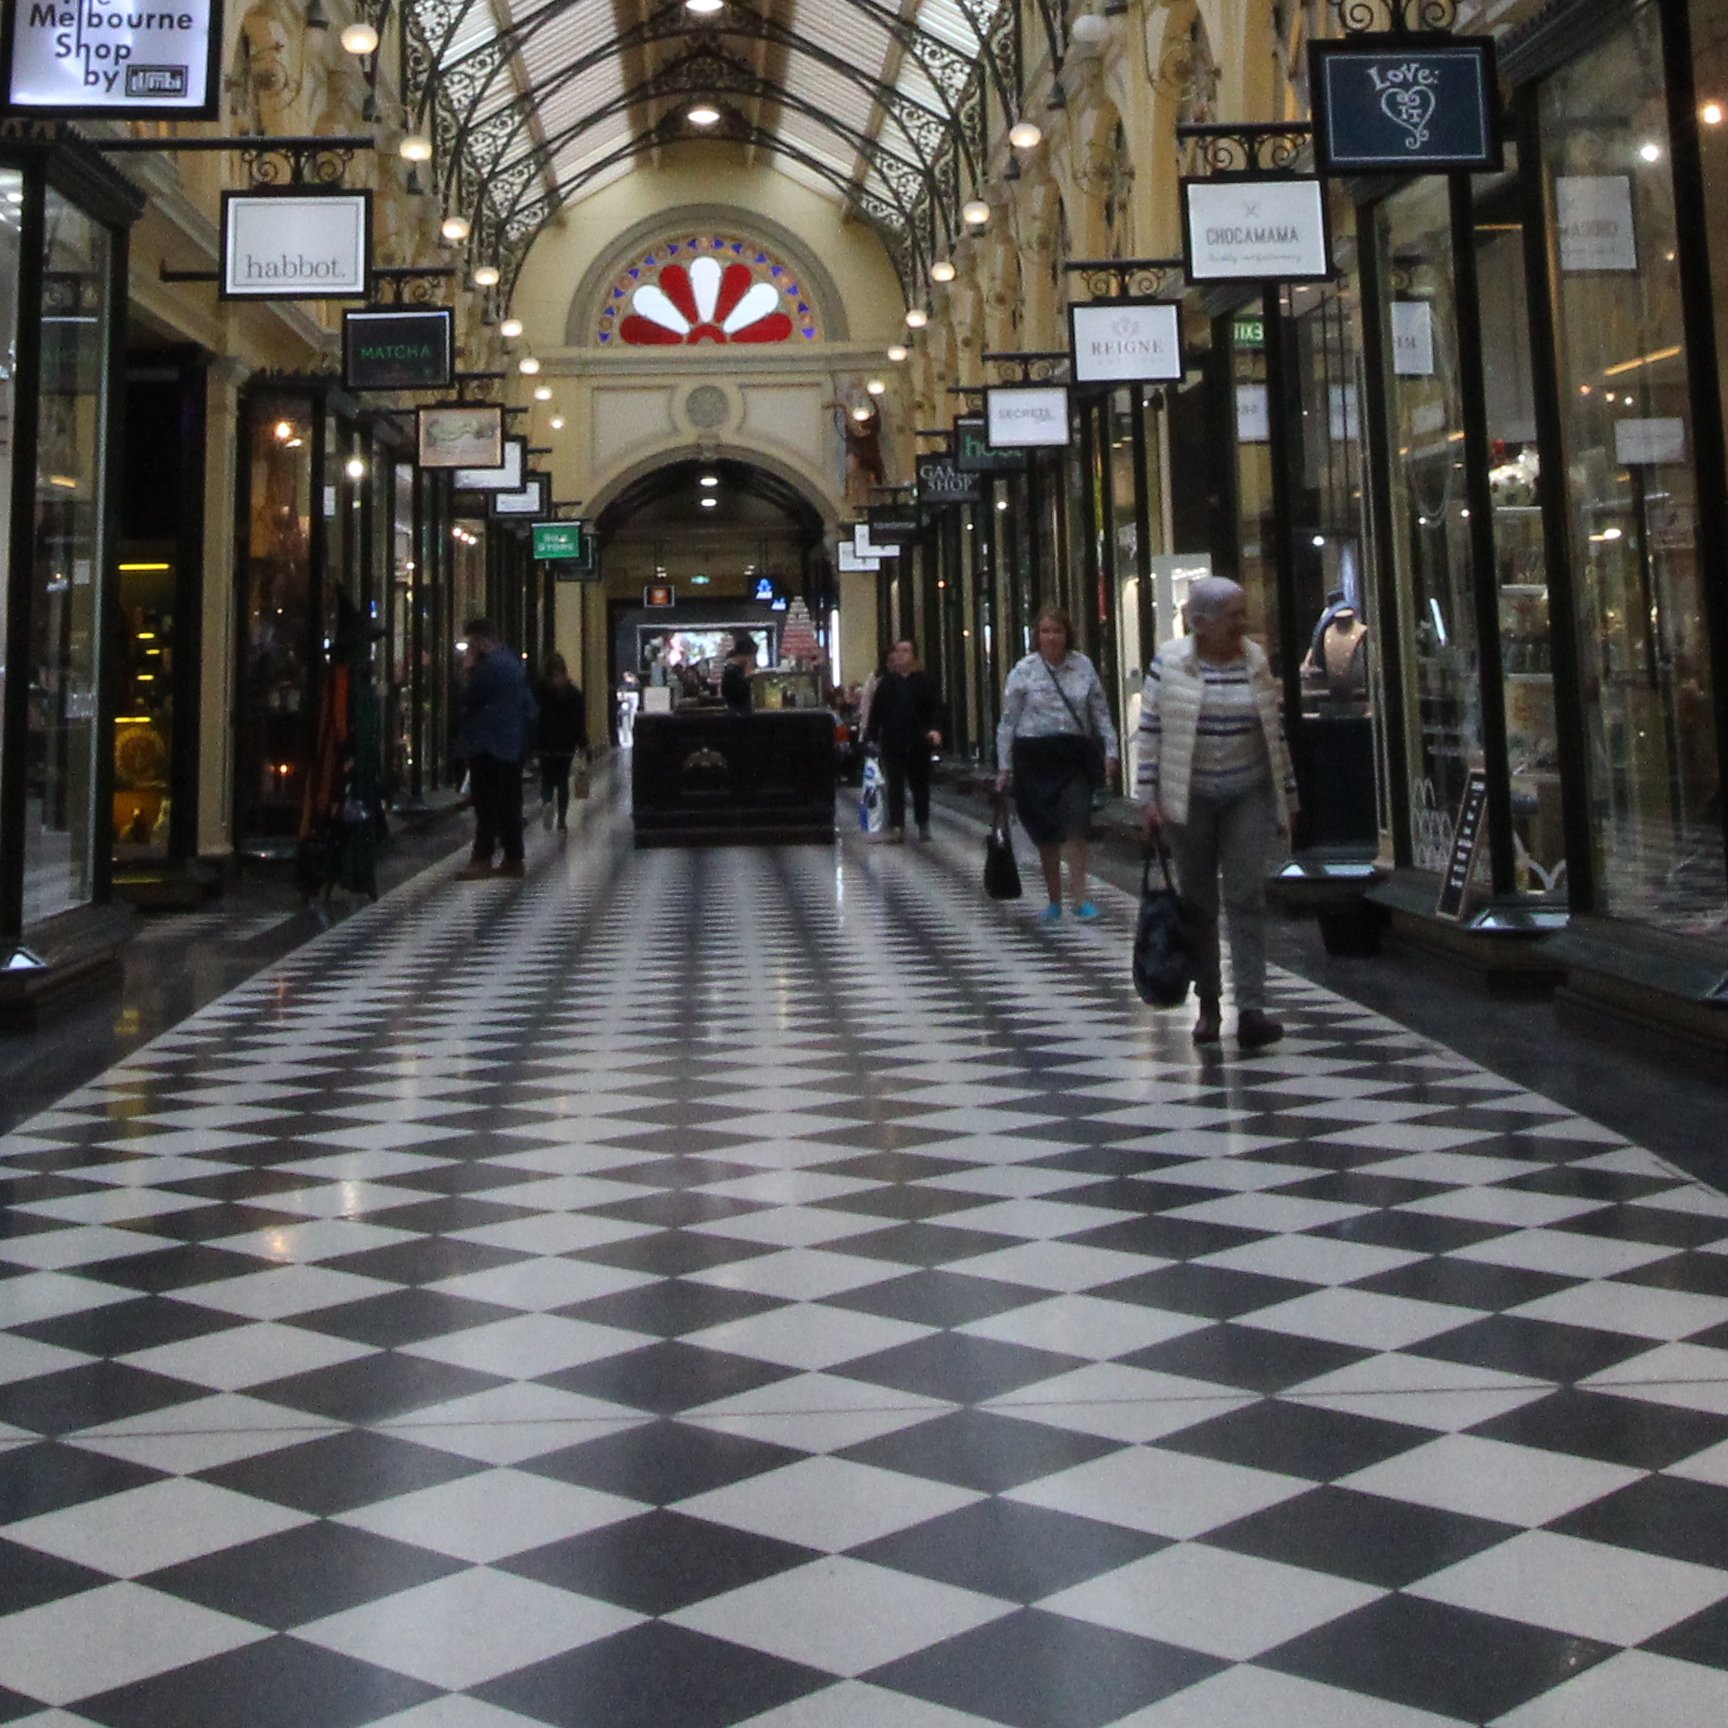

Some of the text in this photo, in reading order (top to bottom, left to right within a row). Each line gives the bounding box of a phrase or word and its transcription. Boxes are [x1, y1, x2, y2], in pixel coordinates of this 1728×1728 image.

[29, 2, 193, 30] Melbourne
[55, 33, 132, 66] Shop
[83, 64, 120, 92] by
[1205, 225, 1300, 246] CHOCAMAMA
[245, 254, 346, 280] habbot.
[358, 343, 432, 360] MATCHA
[1091, 339, 1164, 355] REIGNE
[927, 478, 973, 492] SHOP
